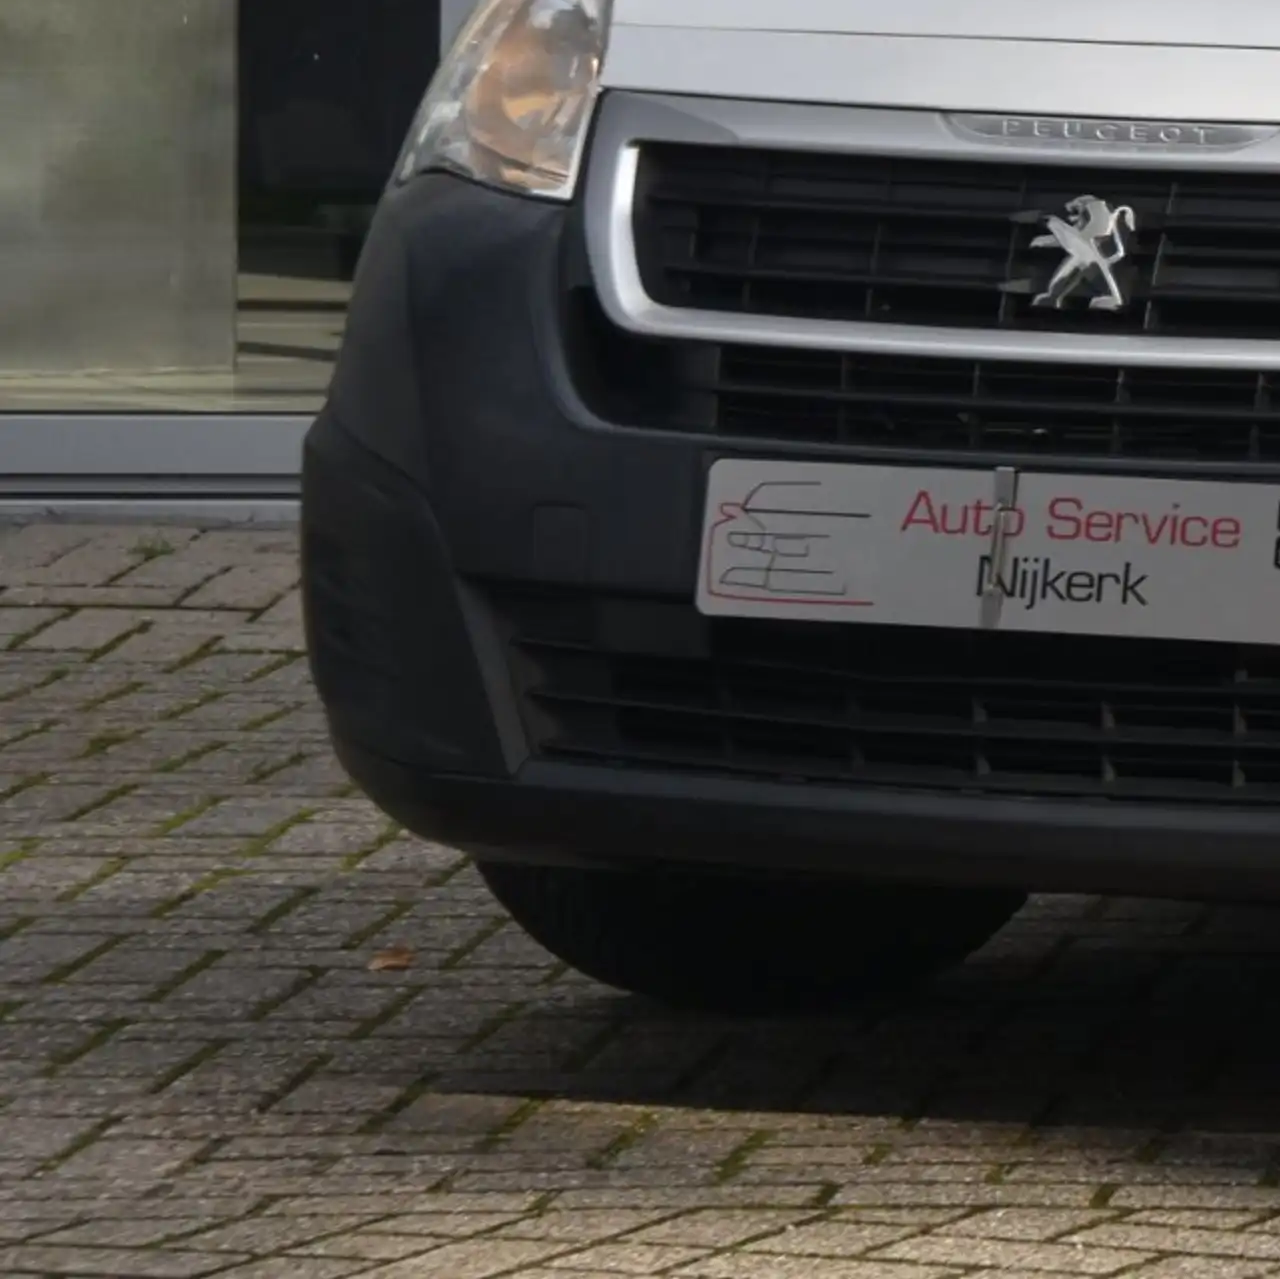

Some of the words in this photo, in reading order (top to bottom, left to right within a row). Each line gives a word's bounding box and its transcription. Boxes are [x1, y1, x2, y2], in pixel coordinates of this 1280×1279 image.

[1001, 118, 1215, 146] PEUGEOT
[900, 489, 1026, 539] Auto
[1046, 496, 1243, 549] Service
[975, 554, 1149, 610] Nijkerk
